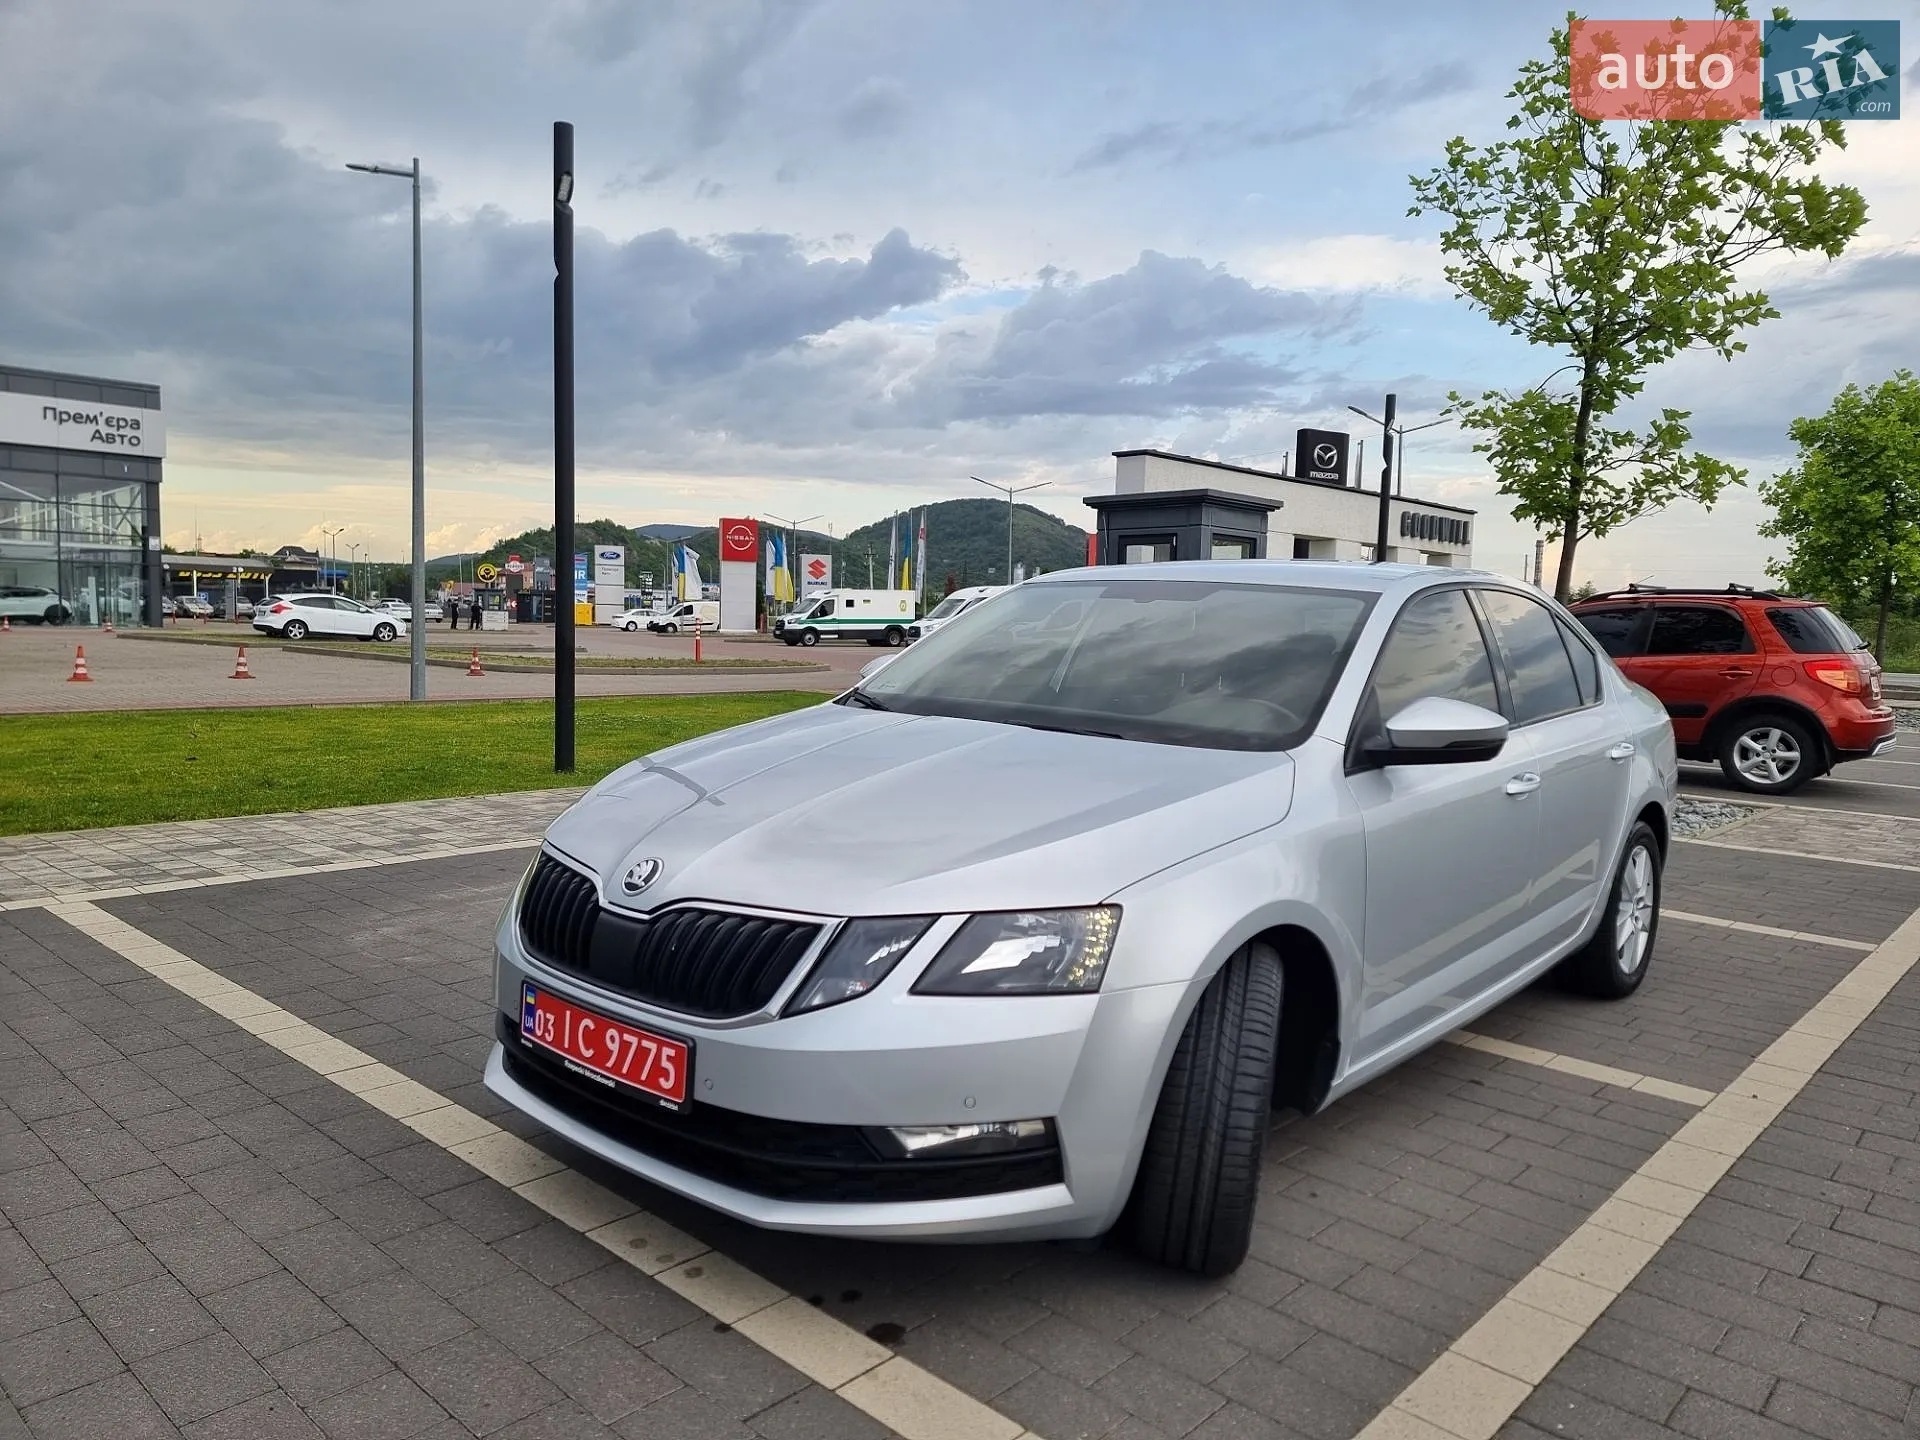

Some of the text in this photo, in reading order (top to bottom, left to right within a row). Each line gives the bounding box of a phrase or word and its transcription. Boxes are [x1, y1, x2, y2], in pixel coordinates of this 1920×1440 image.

[43, 406, 141, 431] Прем'єра
[90, 429, 141, 447] Авто
[726, 534, 755, 542] NISSAN
[524, 1015, 534, 1030] UA
[535, 1009, 555, 1042] 03
[564, 1010, 596, 1058] IC
[605, 1028, 676, 1090] 9775
